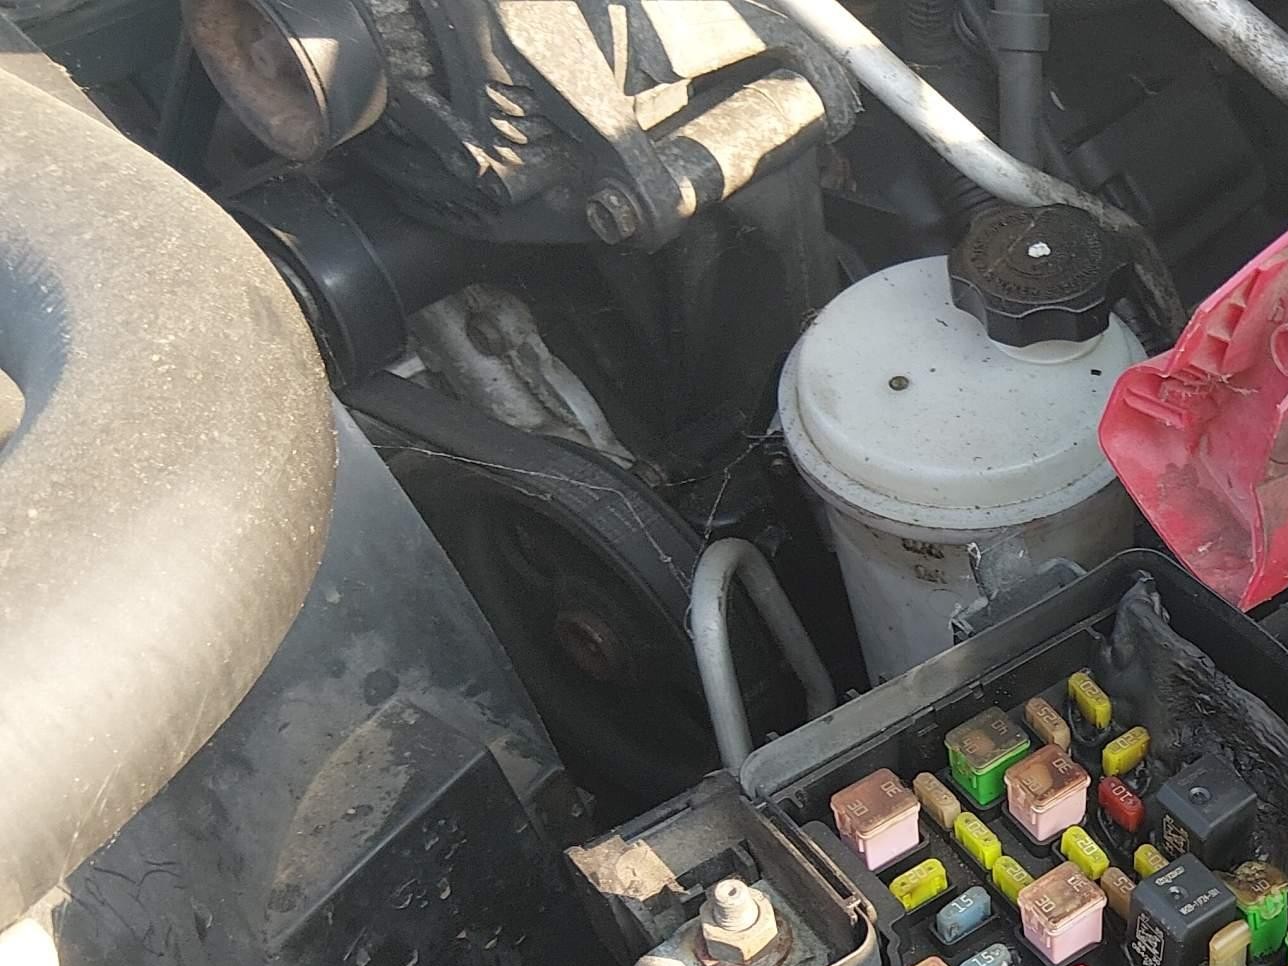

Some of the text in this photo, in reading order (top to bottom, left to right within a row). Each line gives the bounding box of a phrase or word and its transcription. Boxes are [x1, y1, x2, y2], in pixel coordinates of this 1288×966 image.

[1079, 680, 1099, 697] 20
[1037, 706, 1060, 727] 25
[991, 720, 1009, 735] 40
[963, 737, 978, 754] 40
[1052, 758, 1073, 775] 30
[880, 781, 902, 798] 30
[1022, 777, 1042, 792] 30
[1112, 784, 1133, 802] 10
[847, 799, 869, 817] 30
[967, 822, 989, 839] 20
[1075, 836, 1098, 856] 20
[906, 865, 929, 884] 20
[1006, 863, 1027, 882] 20
[1067, 875, 1087, 892] 30
[1113, 875, 1137, 893] 25
[1251, 879, 1271, 894] 40
[951, 894, 974, 913] 15
[1034, 894, 1057, 913] 30
